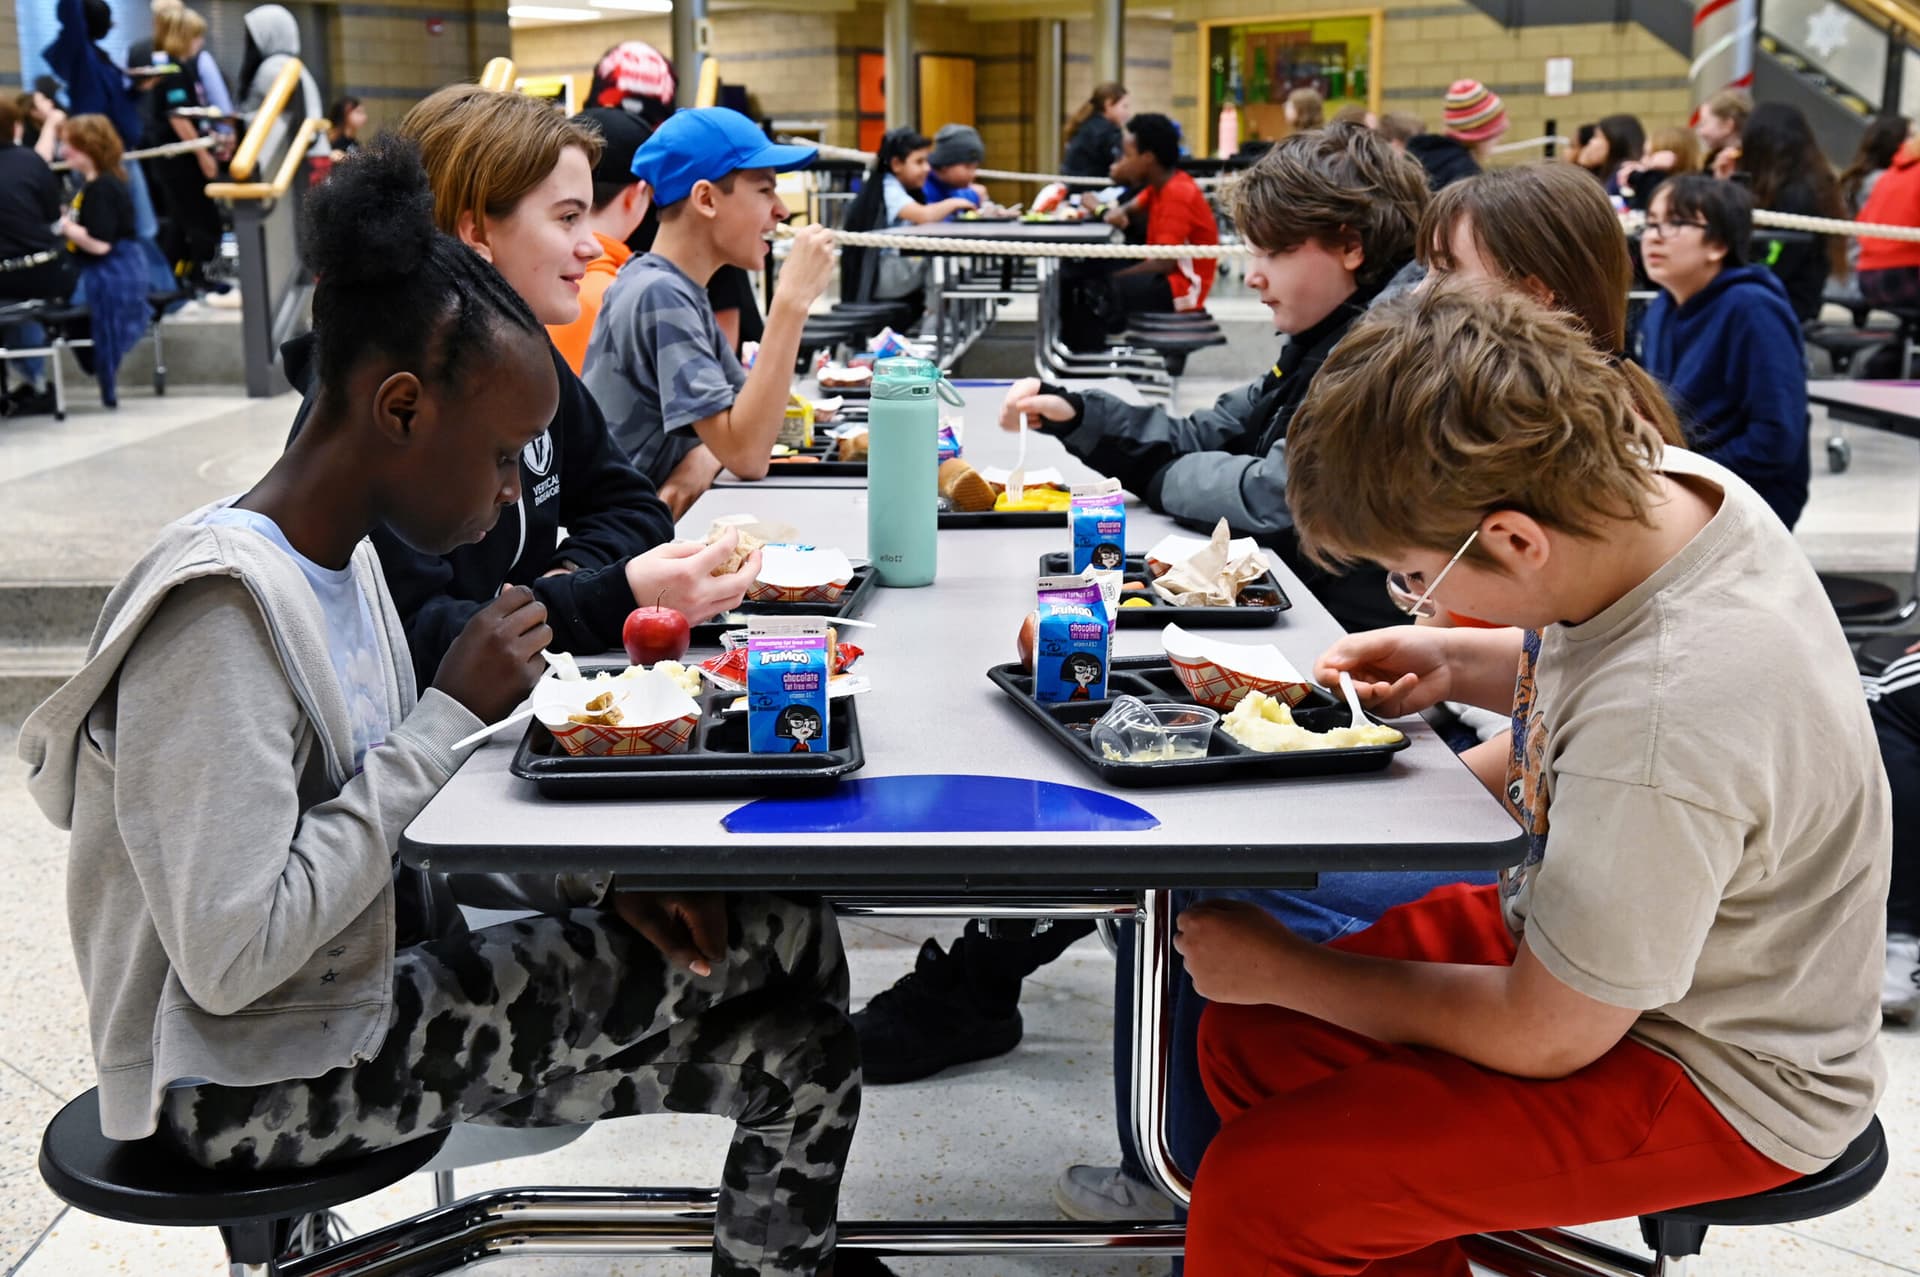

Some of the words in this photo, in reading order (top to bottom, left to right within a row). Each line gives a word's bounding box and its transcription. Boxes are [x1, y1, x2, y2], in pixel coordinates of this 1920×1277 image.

[1051, 604, 1093, 618] TruMoo
[1070, 623, 1102, 633] chocolate
[760, 650, 810, 665] TruMoo
[783, 672, 819, 683] chocolate
[784, 682, 793, 691] fat
[793, 682, 805, 690] free
[805, 682, 818, 690] milk
